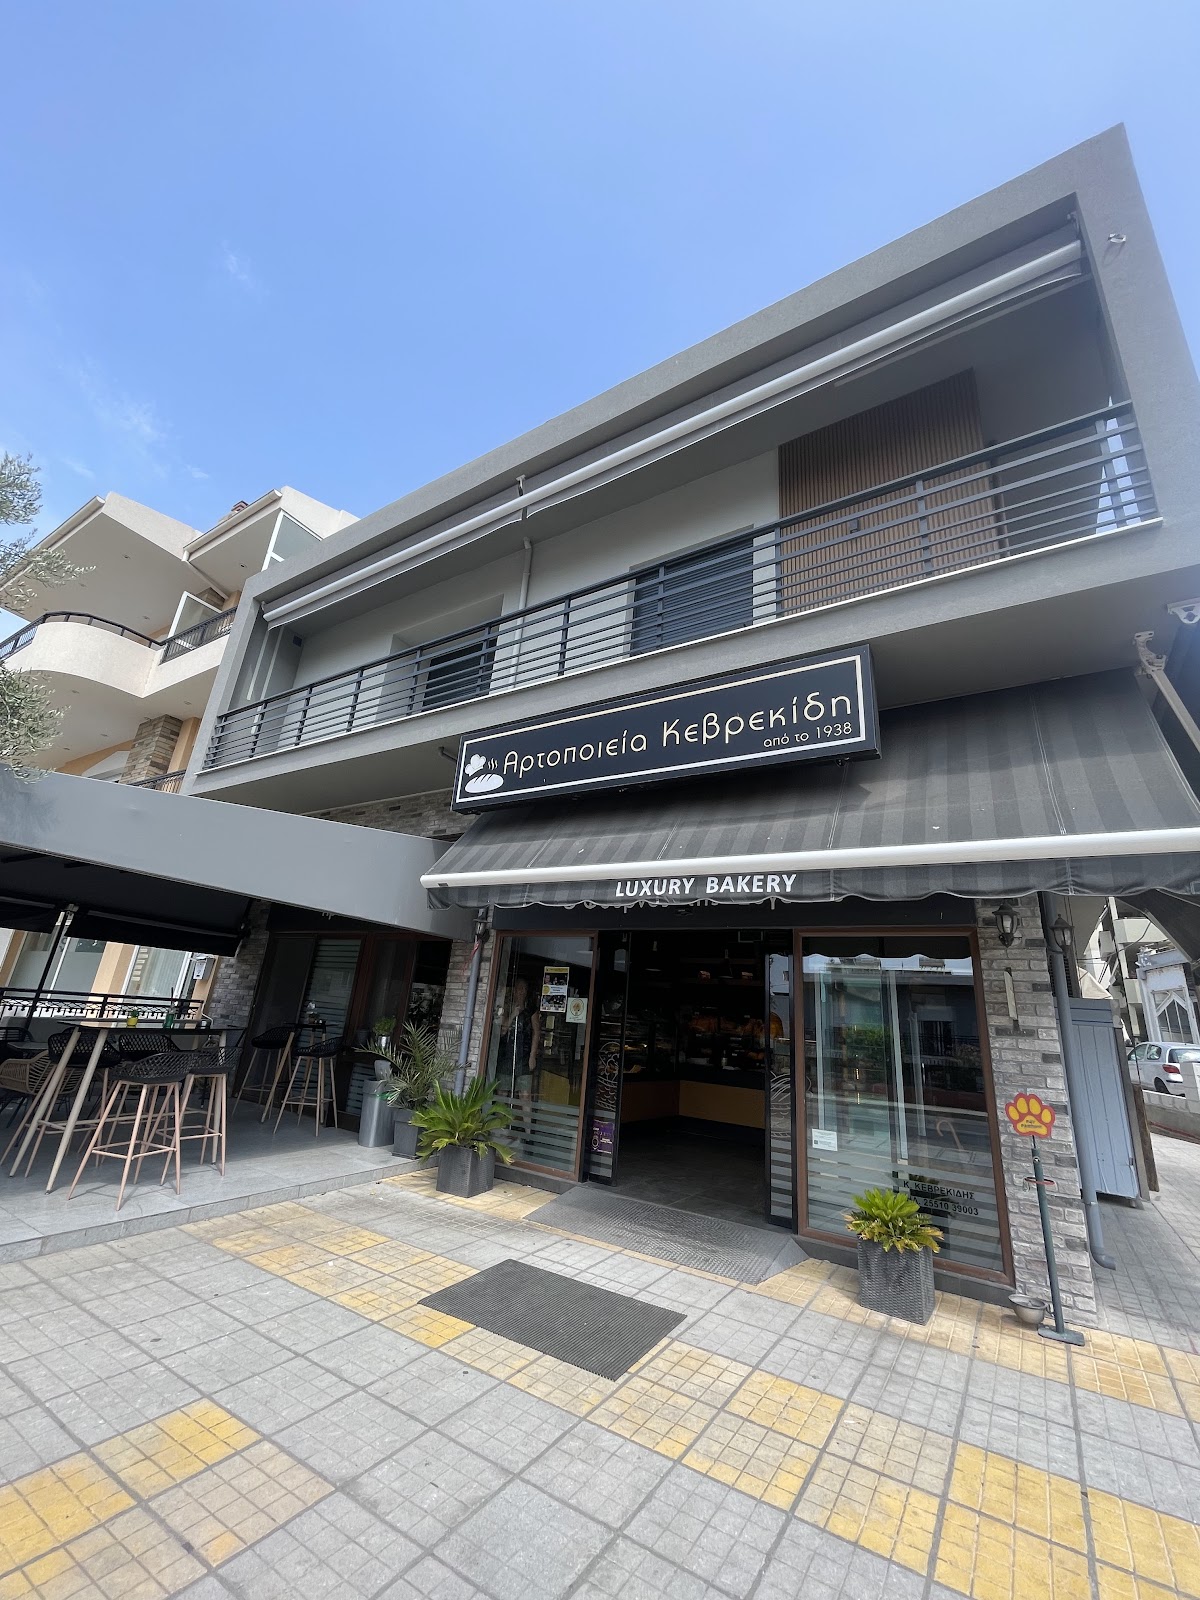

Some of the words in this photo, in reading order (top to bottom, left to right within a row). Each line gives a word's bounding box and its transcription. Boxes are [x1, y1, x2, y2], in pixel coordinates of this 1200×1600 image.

[503, 729, 647, 778] Αρτοποιεία
[663, 692, 851, 747] Κεβρεκίδη
[763, 733, 790, 747] από
[794, 732, 809, 742] το
[816, 722, 852, 739] 1938
[615, 878, 695, 897] LUXURY
[705, 874, 797, 894] BAKERY
[914, 1183, 975, 1200] ΚΕΒΡΕΚΙΔΗΣ
[923, 1199, 949, 1210] 25510
[952, 1203, 978, 1215] 39003
